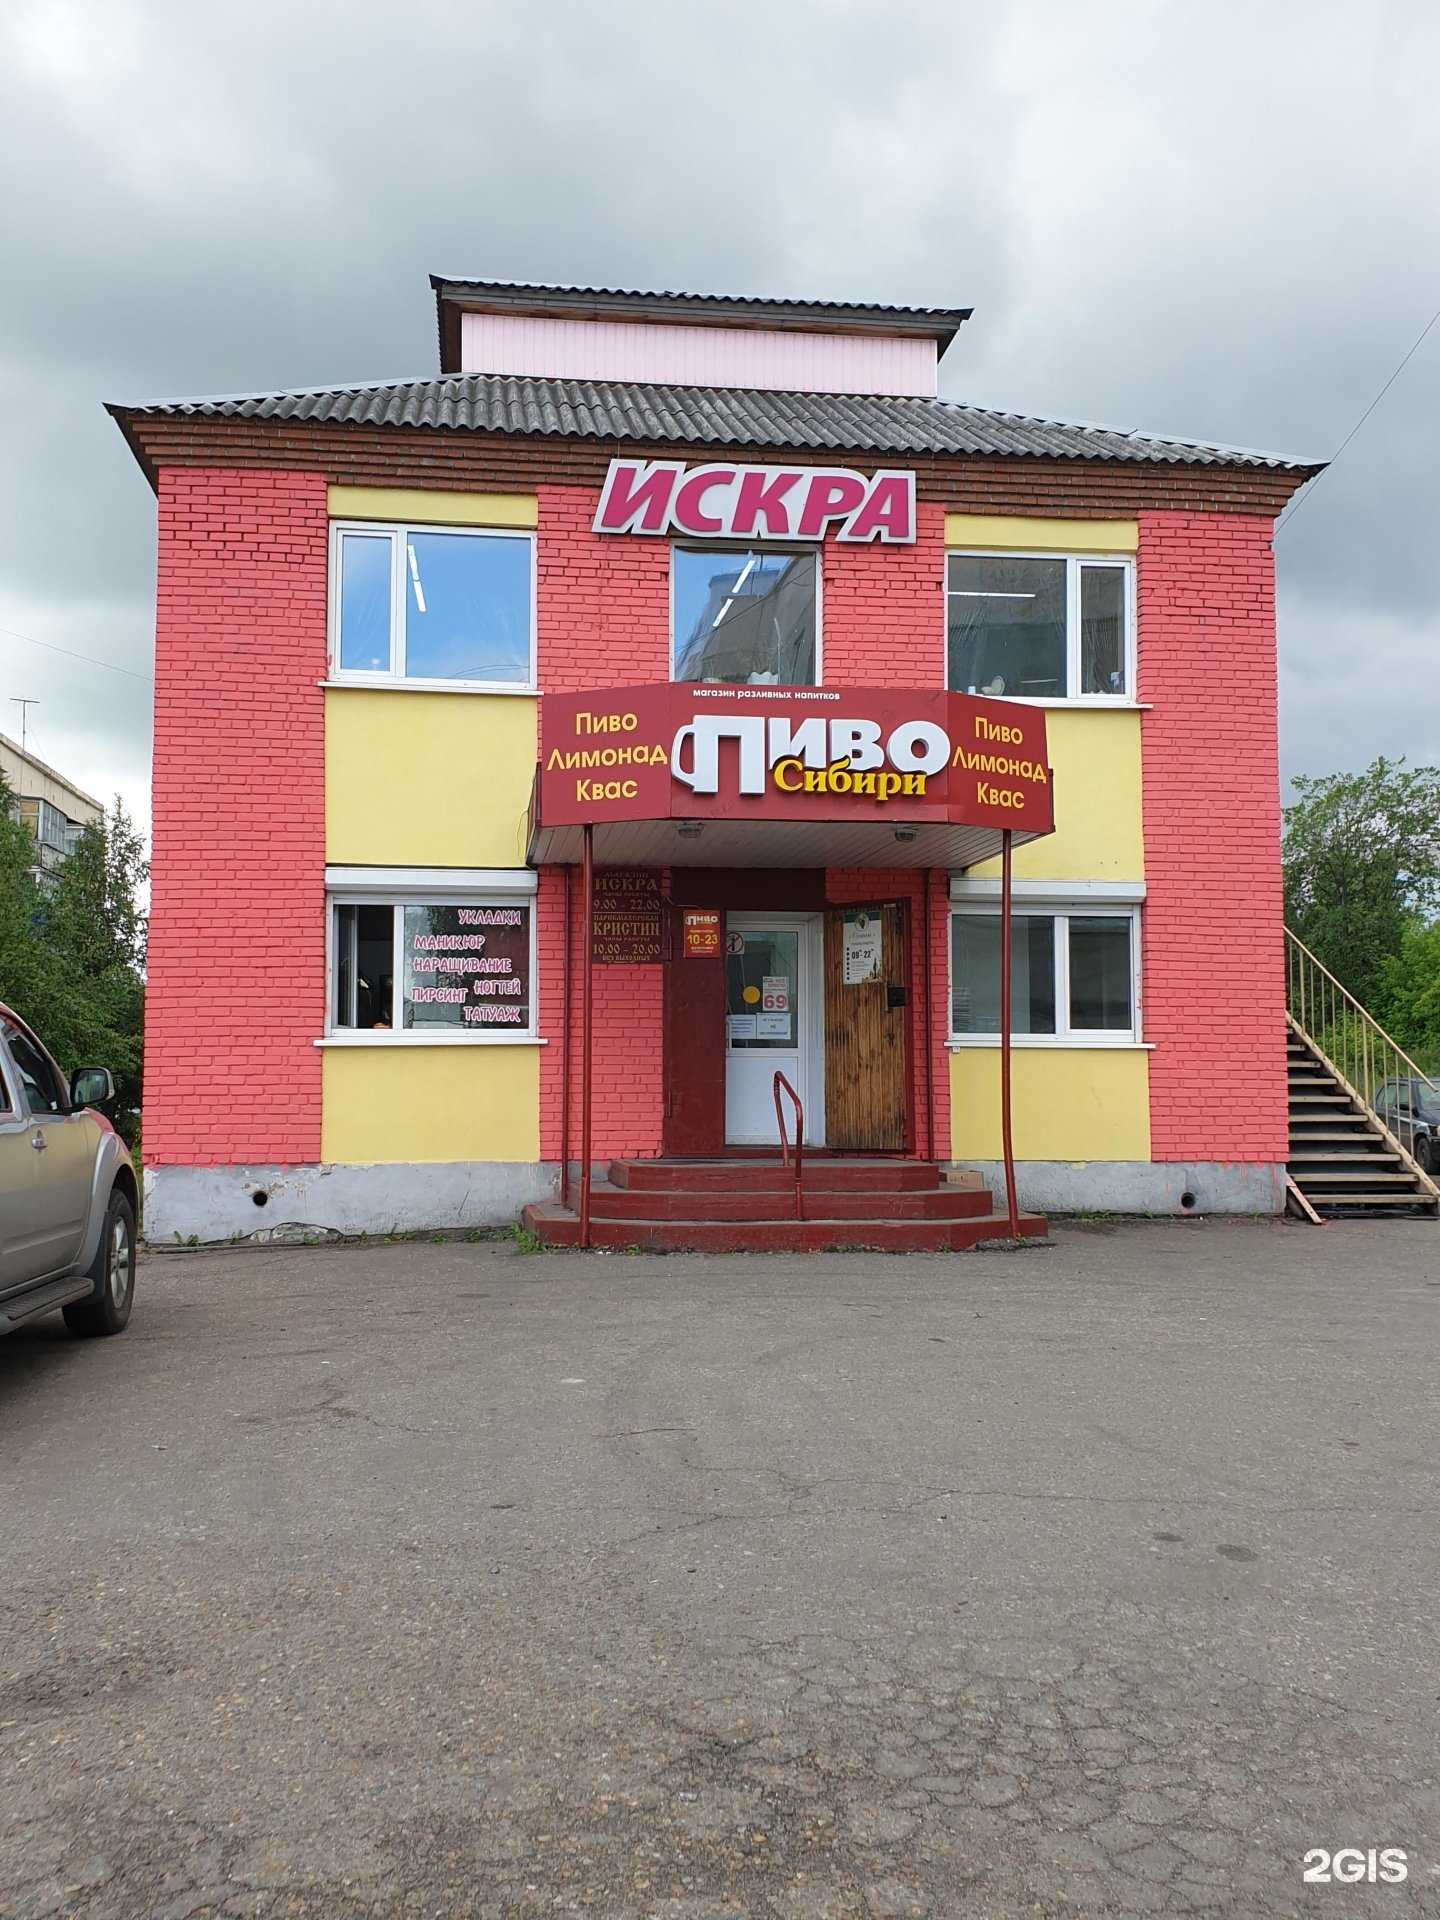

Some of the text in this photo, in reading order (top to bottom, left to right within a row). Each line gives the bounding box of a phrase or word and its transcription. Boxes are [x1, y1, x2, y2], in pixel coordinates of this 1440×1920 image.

[599, 466, 910, 538] ИСКРА
[693, 689, 841, 700] магазин разливных напитков
[576, 712, 638, 735] Пиво
[975, 716, 1023, 745] Пиво
[546, 744, 668, 771] Лимонад
[952, 746, 1047, 784] Лимонад
[773, 756, 927, 801] Сибири
[576, 778, 638, 802] Квас
[977, 781, 1025, 809] Квас
[594, 878, 658, 891] ИСКРА
[458, 909, 521, 925] УКЛАДКИ
[413, 934, 485, 950] МАНИКЮР
[687, 934, 719, 945] 10-23
[593, 943, 621, 955] 10.00
[631, 943, 660, 955] 20.00
[413, 957, 512, 975] НАРАЩИВАНИЕ
[411, 986, 468, 1003] ПИРСИНГ
[474, 977, 521, 995] НОГТЕЙ
[764, 994, 787, 1009] 69
[463, 1006, 521, 1023] ТАТУАЖ
